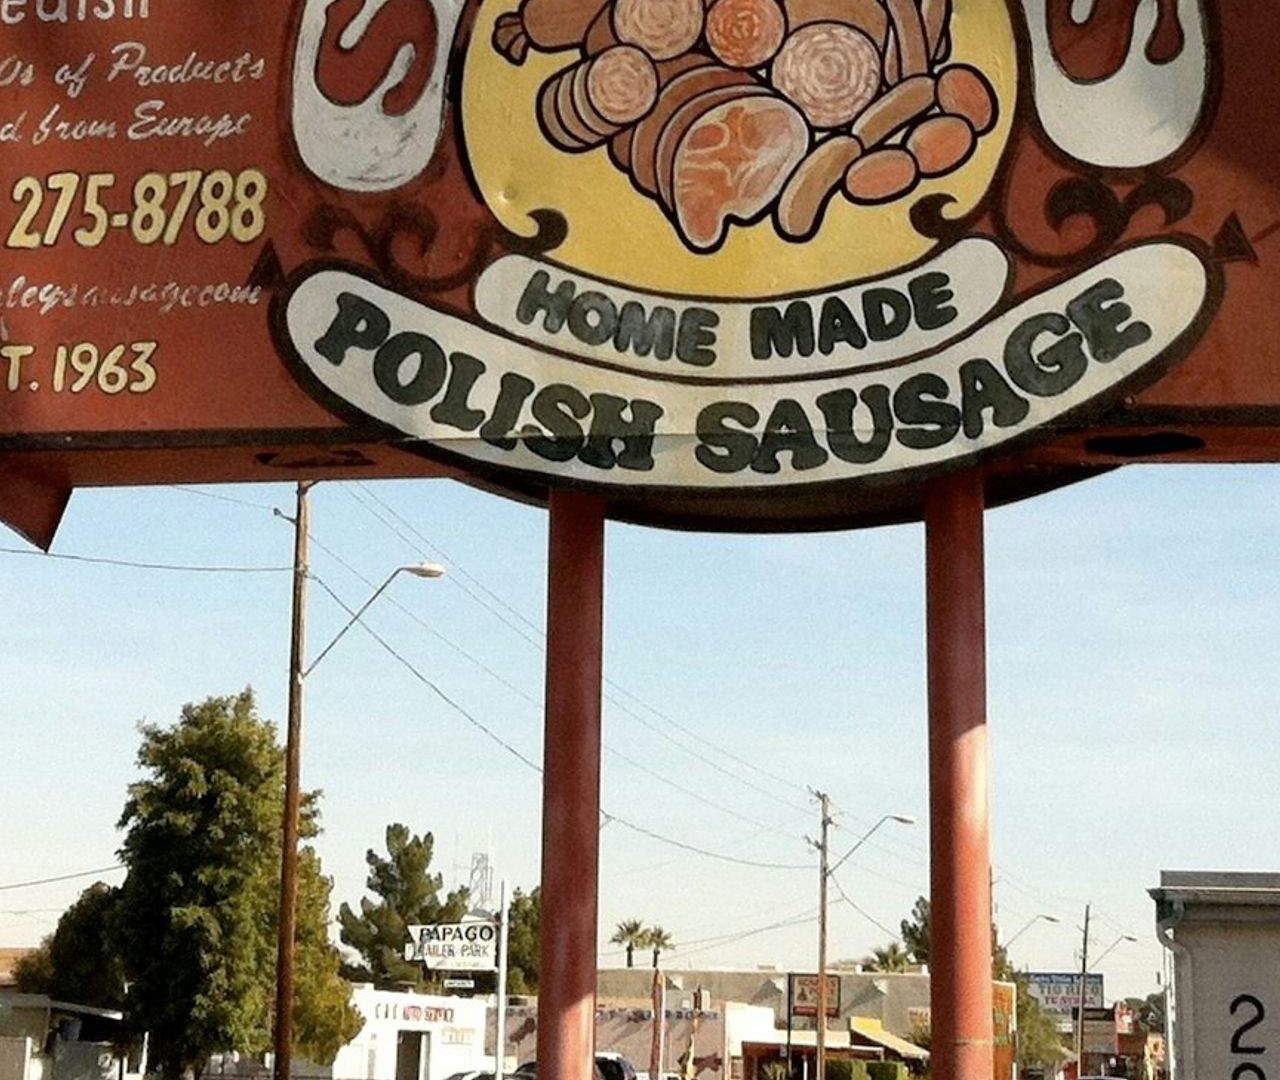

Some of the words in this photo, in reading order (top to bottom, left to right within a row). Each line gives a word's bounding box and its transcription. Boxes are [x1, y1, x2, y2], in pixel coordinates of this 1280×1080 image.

[53, 51, 96, 99] of
[106, 41, 267, 88] Products
[32, 103, 119, 147] from
[126, 100, 253, 148] Europe
[4, 167, 268, 250] 275-8788
[515, 268, 719, 367] HOME
[749, 272, 957, 361] MADE
[51, 340, 159, 396] 1963
[314, 292, 665, 473] POLISH
[694, 276, 1153, 474] SAUSAGE
[420, 924, 494, 942] PAPAGO
[460, 944, 490, 959] PARK
